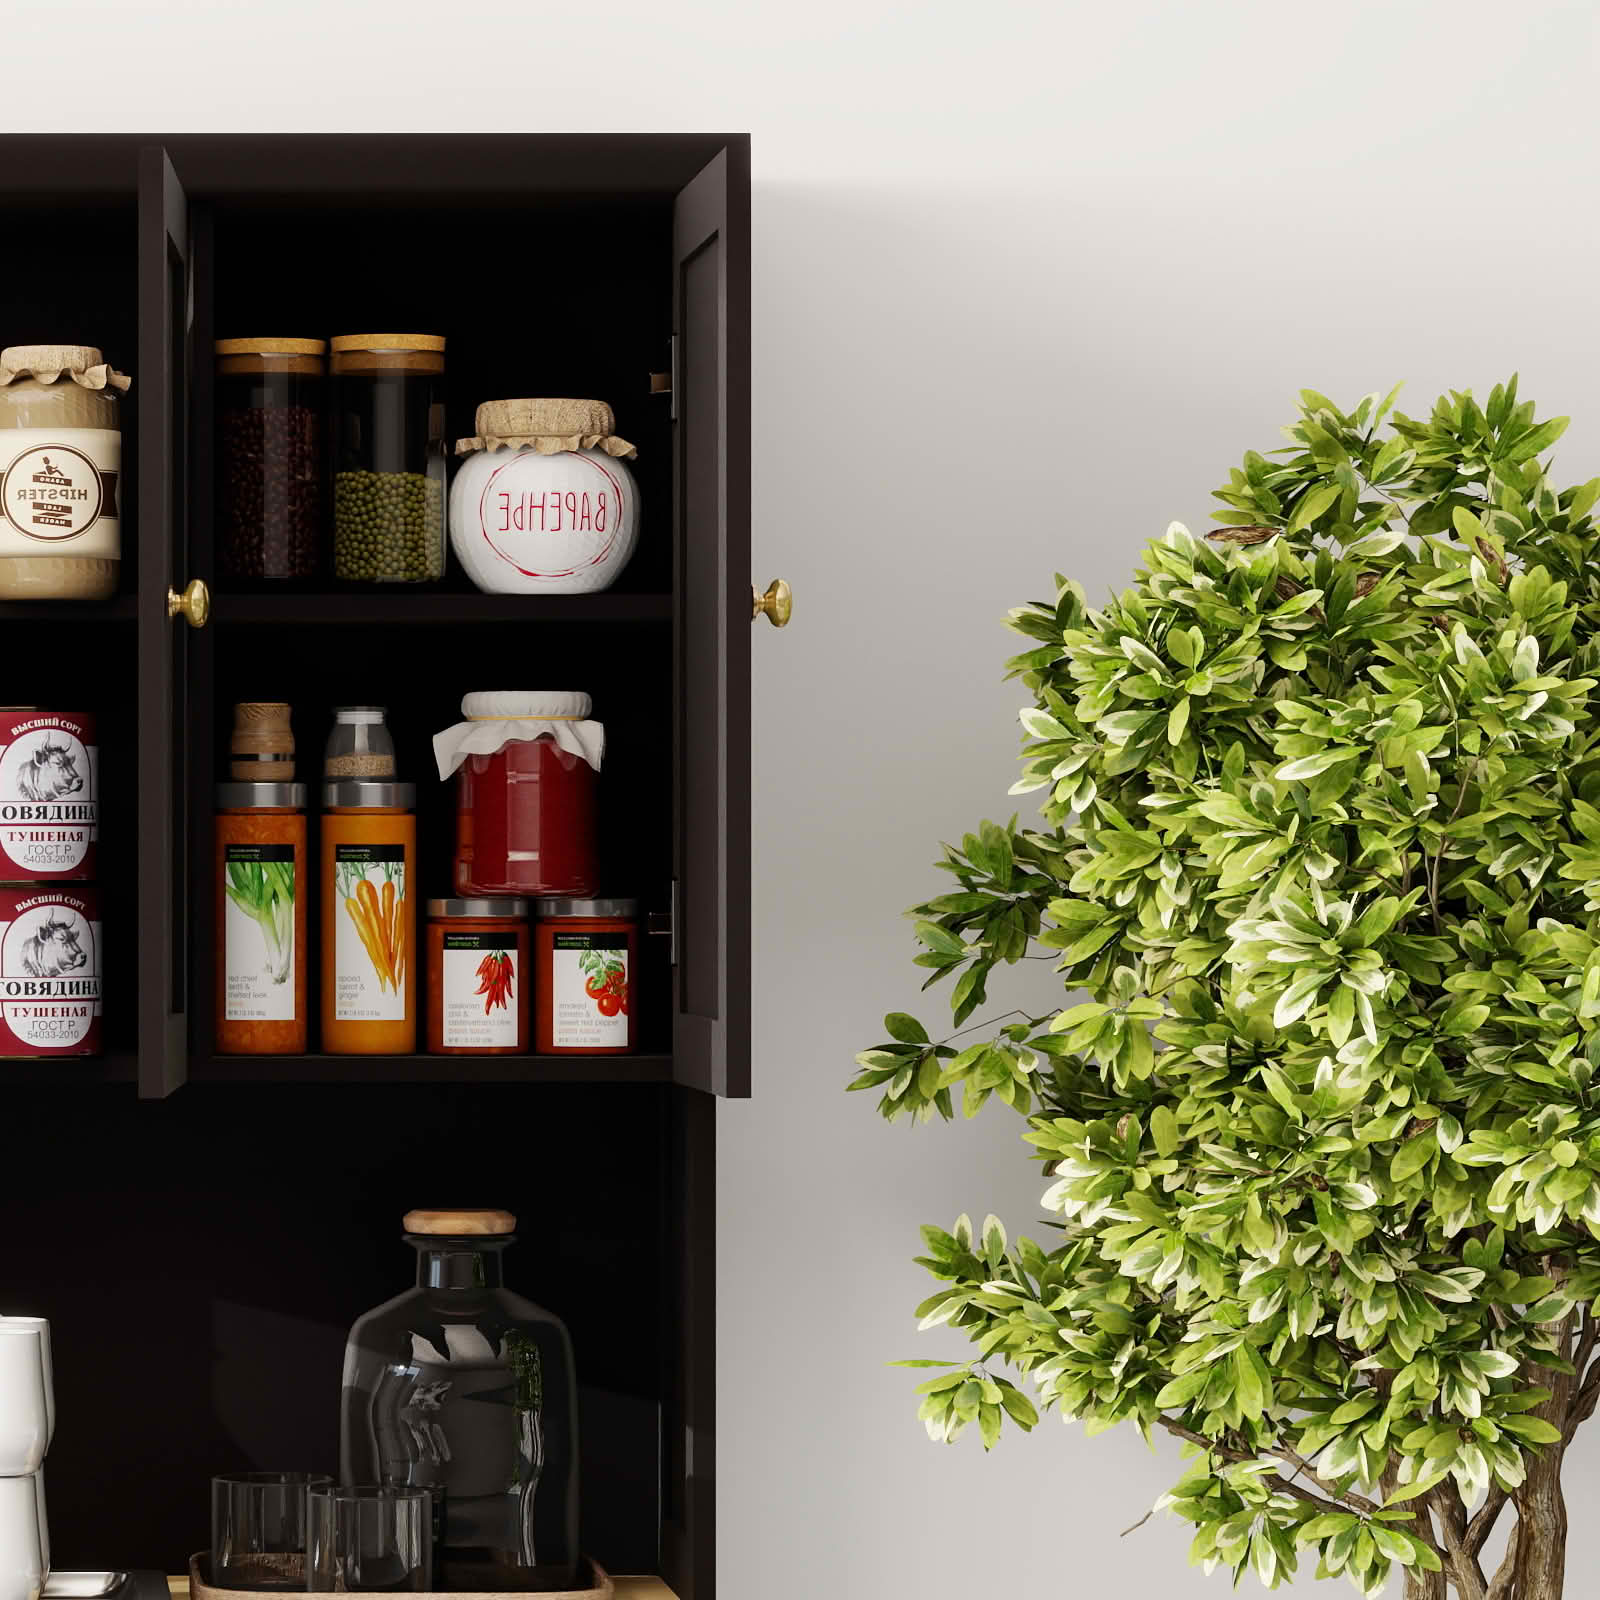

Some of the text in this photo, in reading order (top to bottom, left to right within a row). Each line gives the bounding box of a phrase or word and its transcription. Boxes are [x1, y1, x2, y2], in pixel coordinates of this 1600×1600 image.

[8, 831, 85, 842] ТУШЕНАЯ
[15, 893, 86, 912] ВЫСШИЙ СОРТ
[11, 1007, 88, 1018] ТУШЕНАЯ
